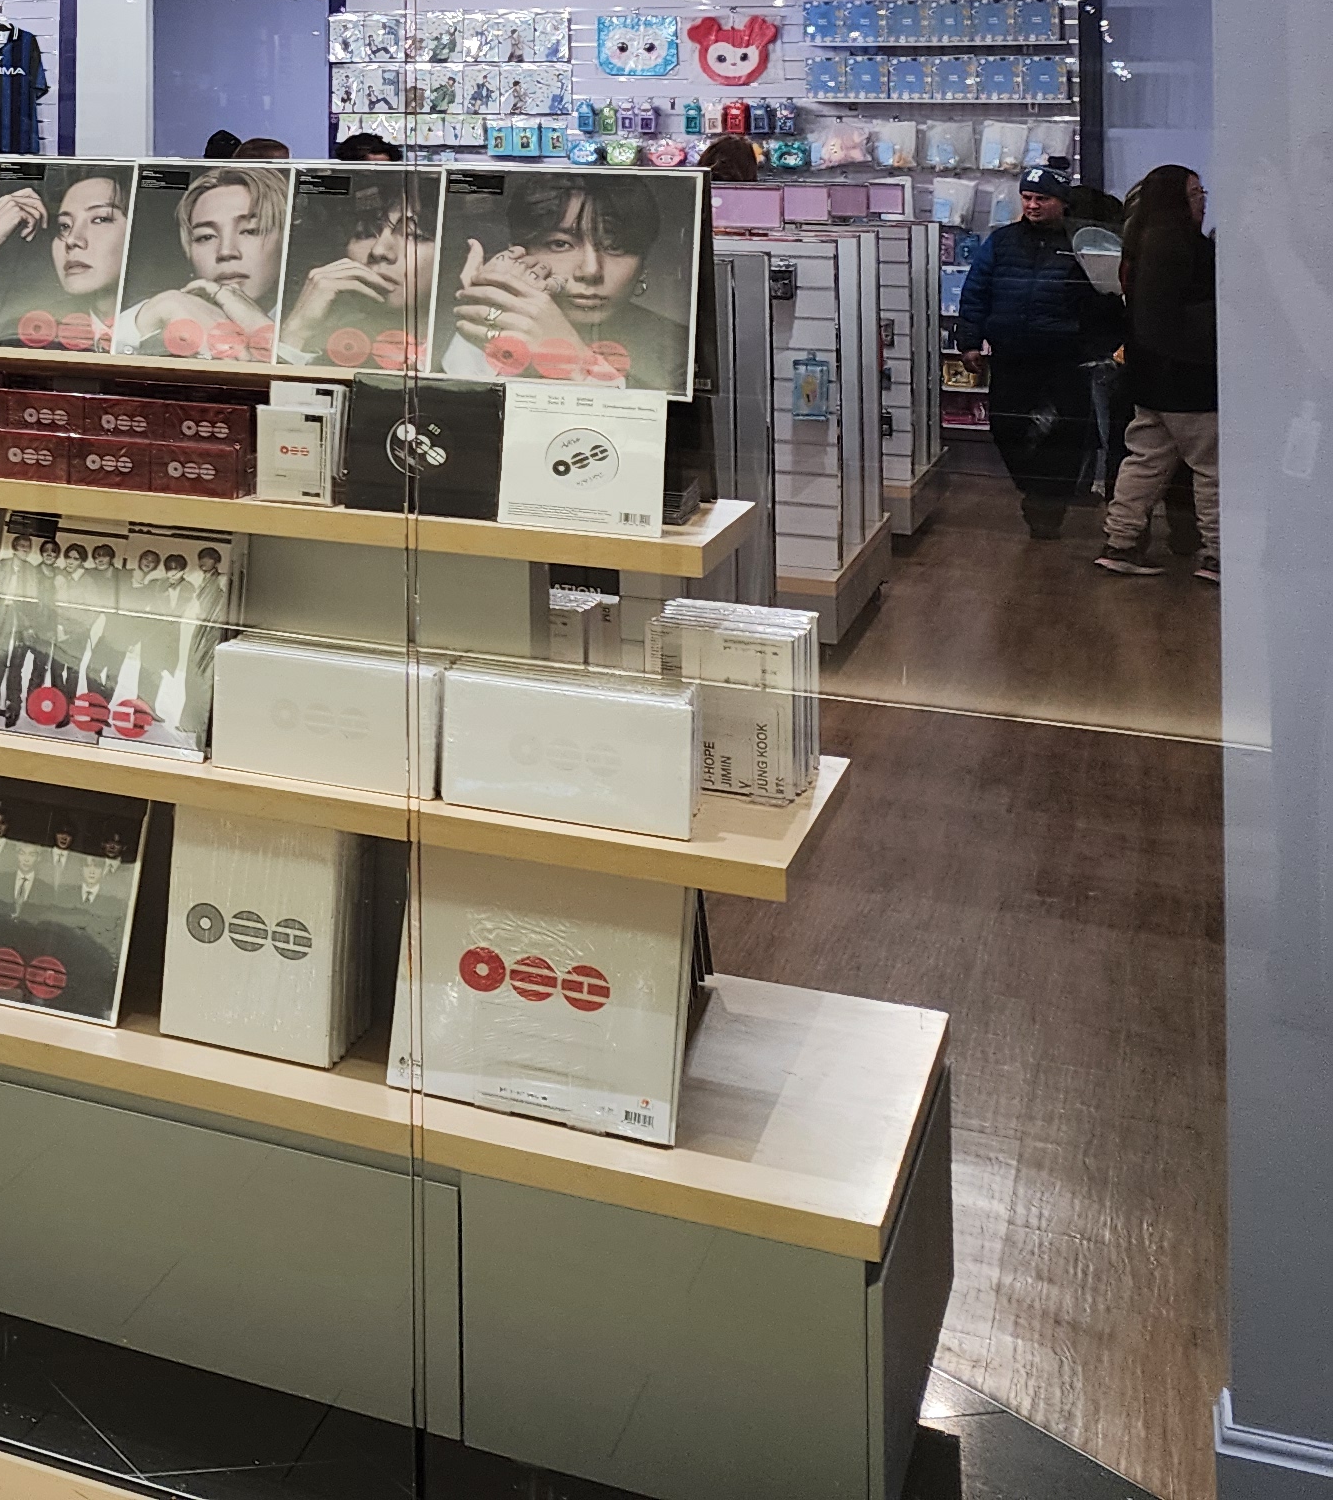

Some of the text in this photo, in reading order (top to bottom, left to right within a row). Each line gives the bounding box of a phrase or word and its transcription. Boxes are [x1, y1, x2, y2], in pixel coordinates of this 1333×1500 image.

[1026, 168, 1044, 183] R
[704, 741, 715, 786] J-HOPE
[720, 755, 732, 787] JIMIN
[756, 722, 769, 793] JUNG KOOK
[738, 780, 752, 789] V
